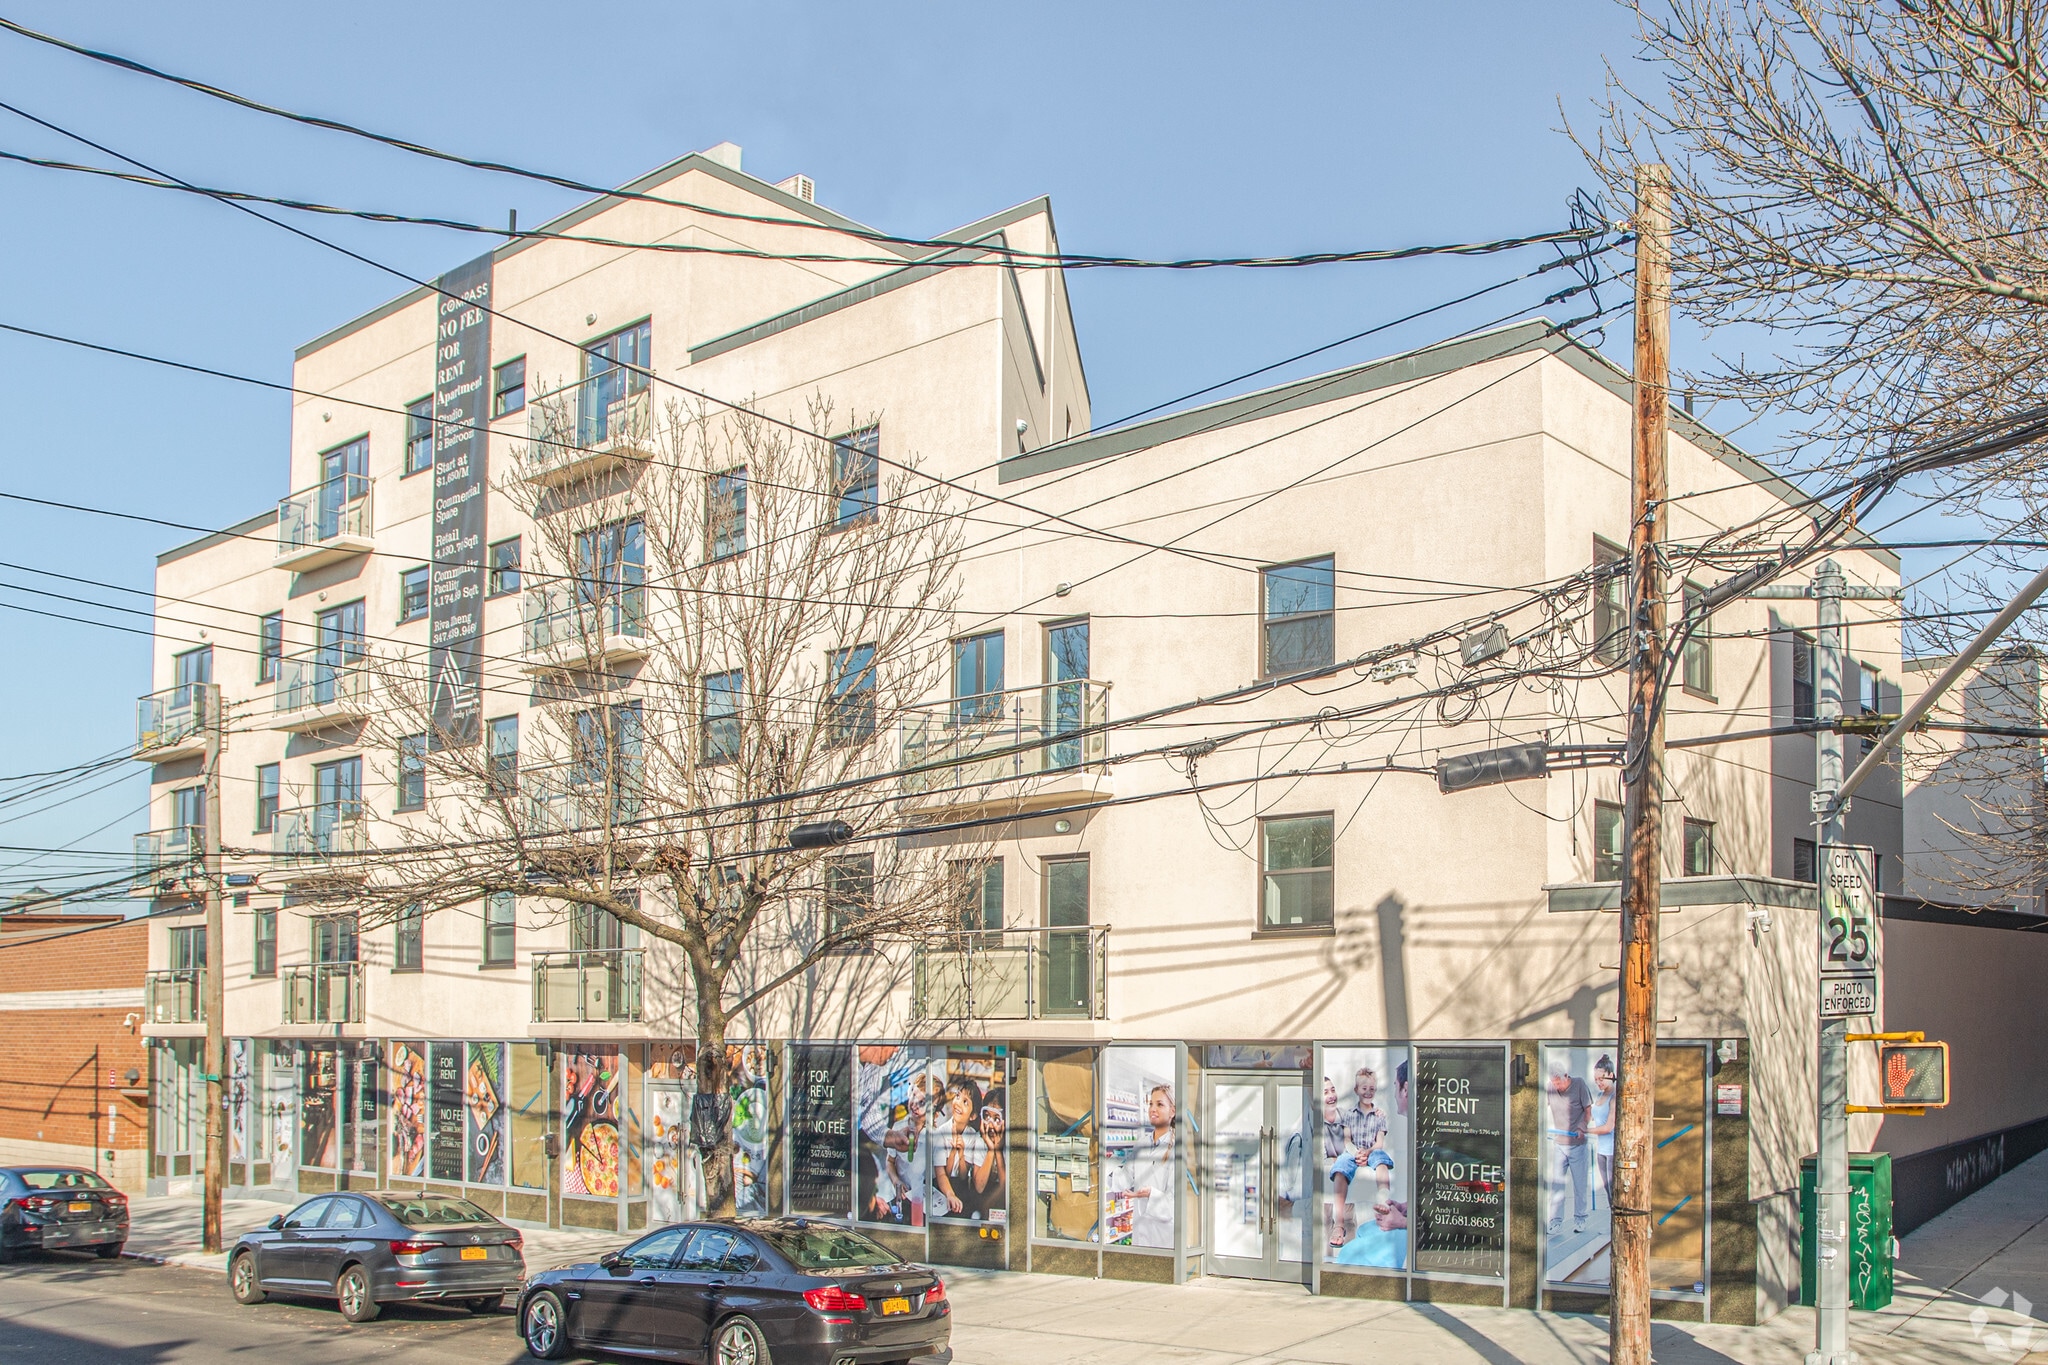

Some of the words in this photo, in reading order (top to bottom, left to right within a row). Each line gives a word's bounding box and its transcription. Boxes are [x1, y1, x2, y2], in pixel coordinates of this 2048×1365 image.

[440, 282, 488, 316] COMPASS
[439, 319, 457, 341] NO
[460, 307, 483, 331] FEE
[439, 341, 460, 363] FOR
[438, 360, 465, 385] RENT
[437, 375, 482, 407] Apartment
[437, 408, 463, 427] Studio
[438, 430, 442, 439] 1
[444, 417, 475, 437] Bedroom
[437, 440, 443, 451] 2
[444, 429, 475, 449] Bedroom
[436, 457, 456, 475] Start
[457, 453, 468, 466] at
[436, 482, 480, 511] Commercial
[436, 507, 458, 524] Space
[435, 528, 460, 547] Retail
[1835, 855, 1856, 868] CITY
[1831, 875, 1862, 889] SPEED
[1835, 894, 1859, 908] LIMIT
[1828, 917, 1869, 962] 25
[1834, 982, 1862, 995] PHOTO
[1825, 996, 1871, 1010] ENFORCED
[440, 1057, 454, 1068] FOR
[440, 1070, 457, 1080] RENT
[810, 1070, 829, 1083] FOR
[810, 1085, 835, 1098] RENT
[1437, 1078, 1470, 1095] FOR
[440, 1108, 452, 1120] NO
[1437, 1097, 1480, 1114] RENT
[811, 1120, 826, 1133] NO
[828, 1121, 846, 1135] FEE
[1436, 1161, 1465, 1180] NO
[1470, 1164, 1501, 1183] FEE
[1450, 1183, 1470, 1192] Zheng
[1435, 1190, 1499, 1204] 347.439.9466
[1435, 1206, 1452, 1215] Andy
[1434, 1213, 1495, 1228] 917.681.8683
